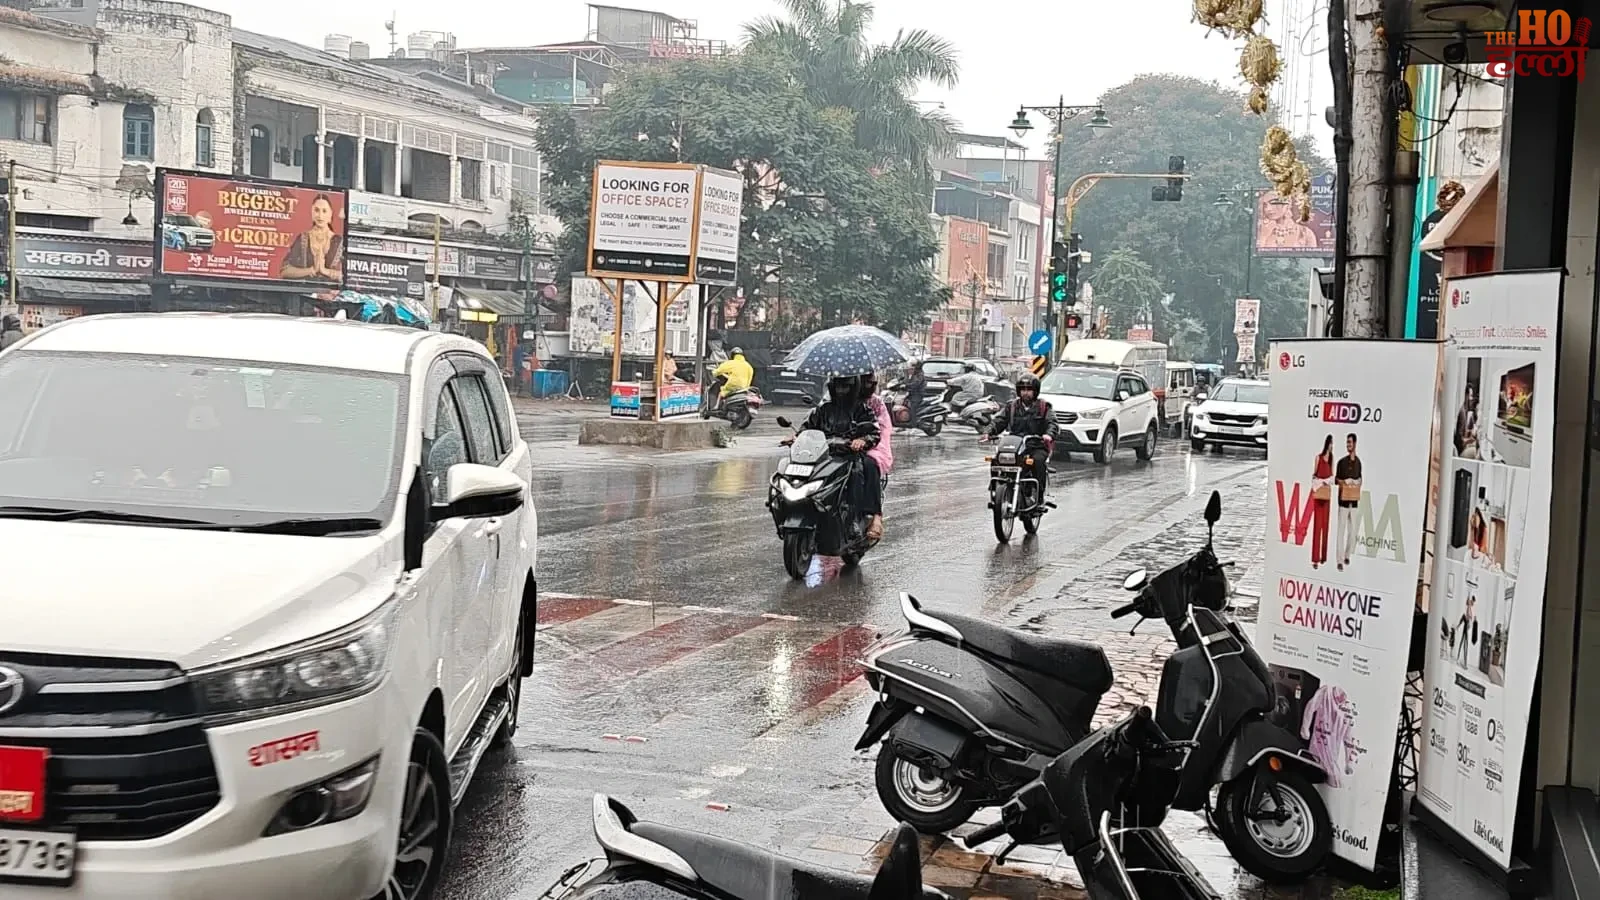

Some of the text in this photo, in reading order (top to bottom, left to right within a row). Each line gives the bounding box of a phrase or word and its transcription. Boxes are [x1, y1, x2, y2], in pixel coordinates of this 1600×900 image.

[602, 179, 690, 194] LOOKING FOR
[704, 186, 740, 202] LOOKING FOR
[217, 190, 299, 214] BIGGEST
[601, 194, 690, 209] OFFICE SPACE?
[703, 200, 720, 214] OFFICE
[600, 212, 625, 220] CHOOSE
[630, 214, 667, 222] COMMERCIAL
[651, 223, 681, 231] COMPLIANT
[24, 248, 112, 267] सहकारी
[207, 254, 232, 264] Kamal
[234, 256, 270, 267] Jewellers
[370, 261, 409, 277] FLORIST
[1461, 290, 1470, 305] LG
[1292, 354, 1306, 368] LG
[1308, 388, 1349, 399] PRESENTING
[1307, 404, 1320, 419] LG
[1362, 407, 1383, 423] 2.0
[1355, 535, 1398, 551] MACHINE
[1279, 577, 1381, 618] NOW ANYONE
[1282, 603, 1363, 641] CAN WASH
[898, 658, 951, 679] Activa
[248, 730, 320, 768] शासन
[1341, 829, 1369, 852] Good.
